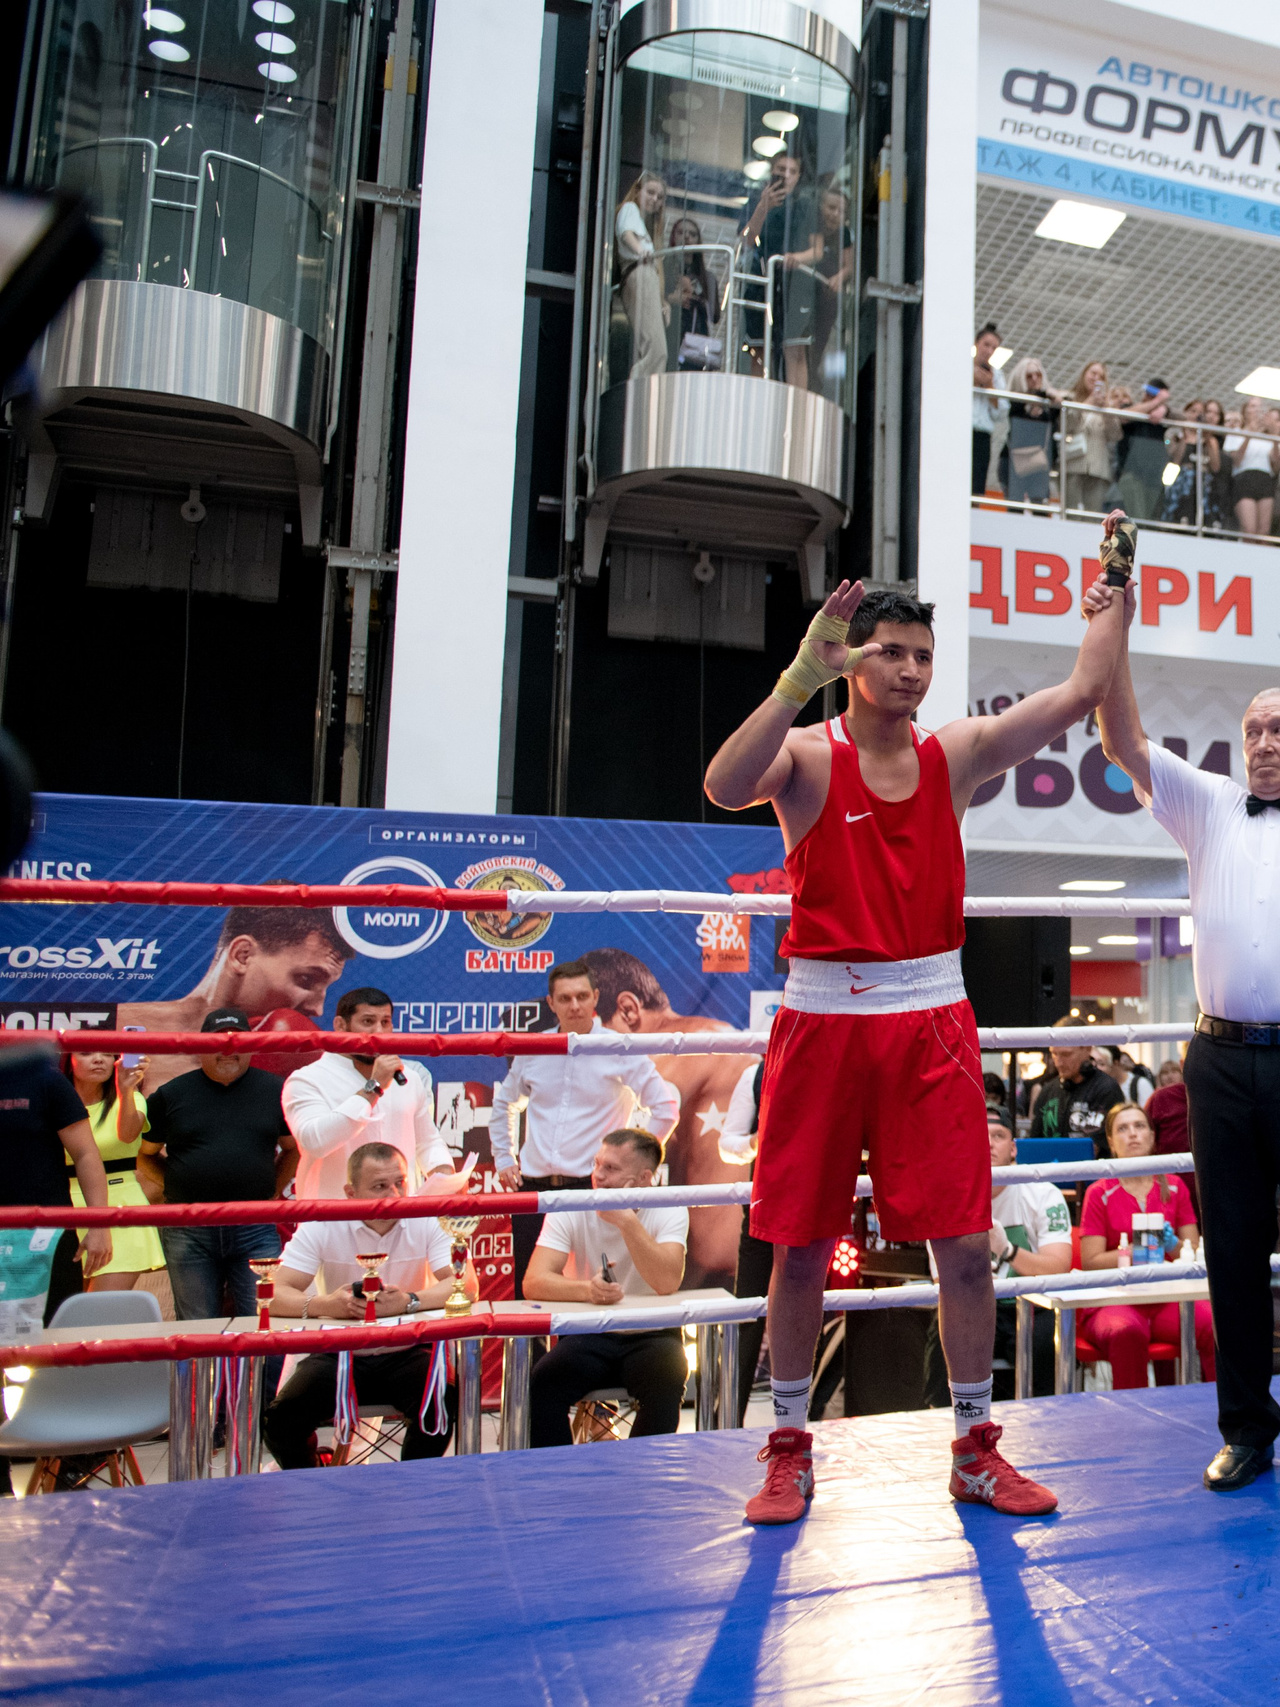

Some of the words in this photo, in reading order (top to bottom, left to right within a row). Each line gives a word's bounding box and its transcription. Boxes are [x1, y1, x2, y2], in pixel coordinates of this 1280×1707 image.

[382, 829, 525, 846] ОРГАНИЗАТОРЫ
[456, 856, 537, 888] БОЙЦОВСКИЙ
[536, 863, 566, 890] КЛУБ
[364, 911, 420, 928] МОЛЛ
[465, 949, 554, 973] БАТЫР
[0, 971, 48, 980] магазин
[51, 972, 115, 982] кроссовок,
[117, 971, 124, 980] 2
[126, 973, 155, 981] этаж
